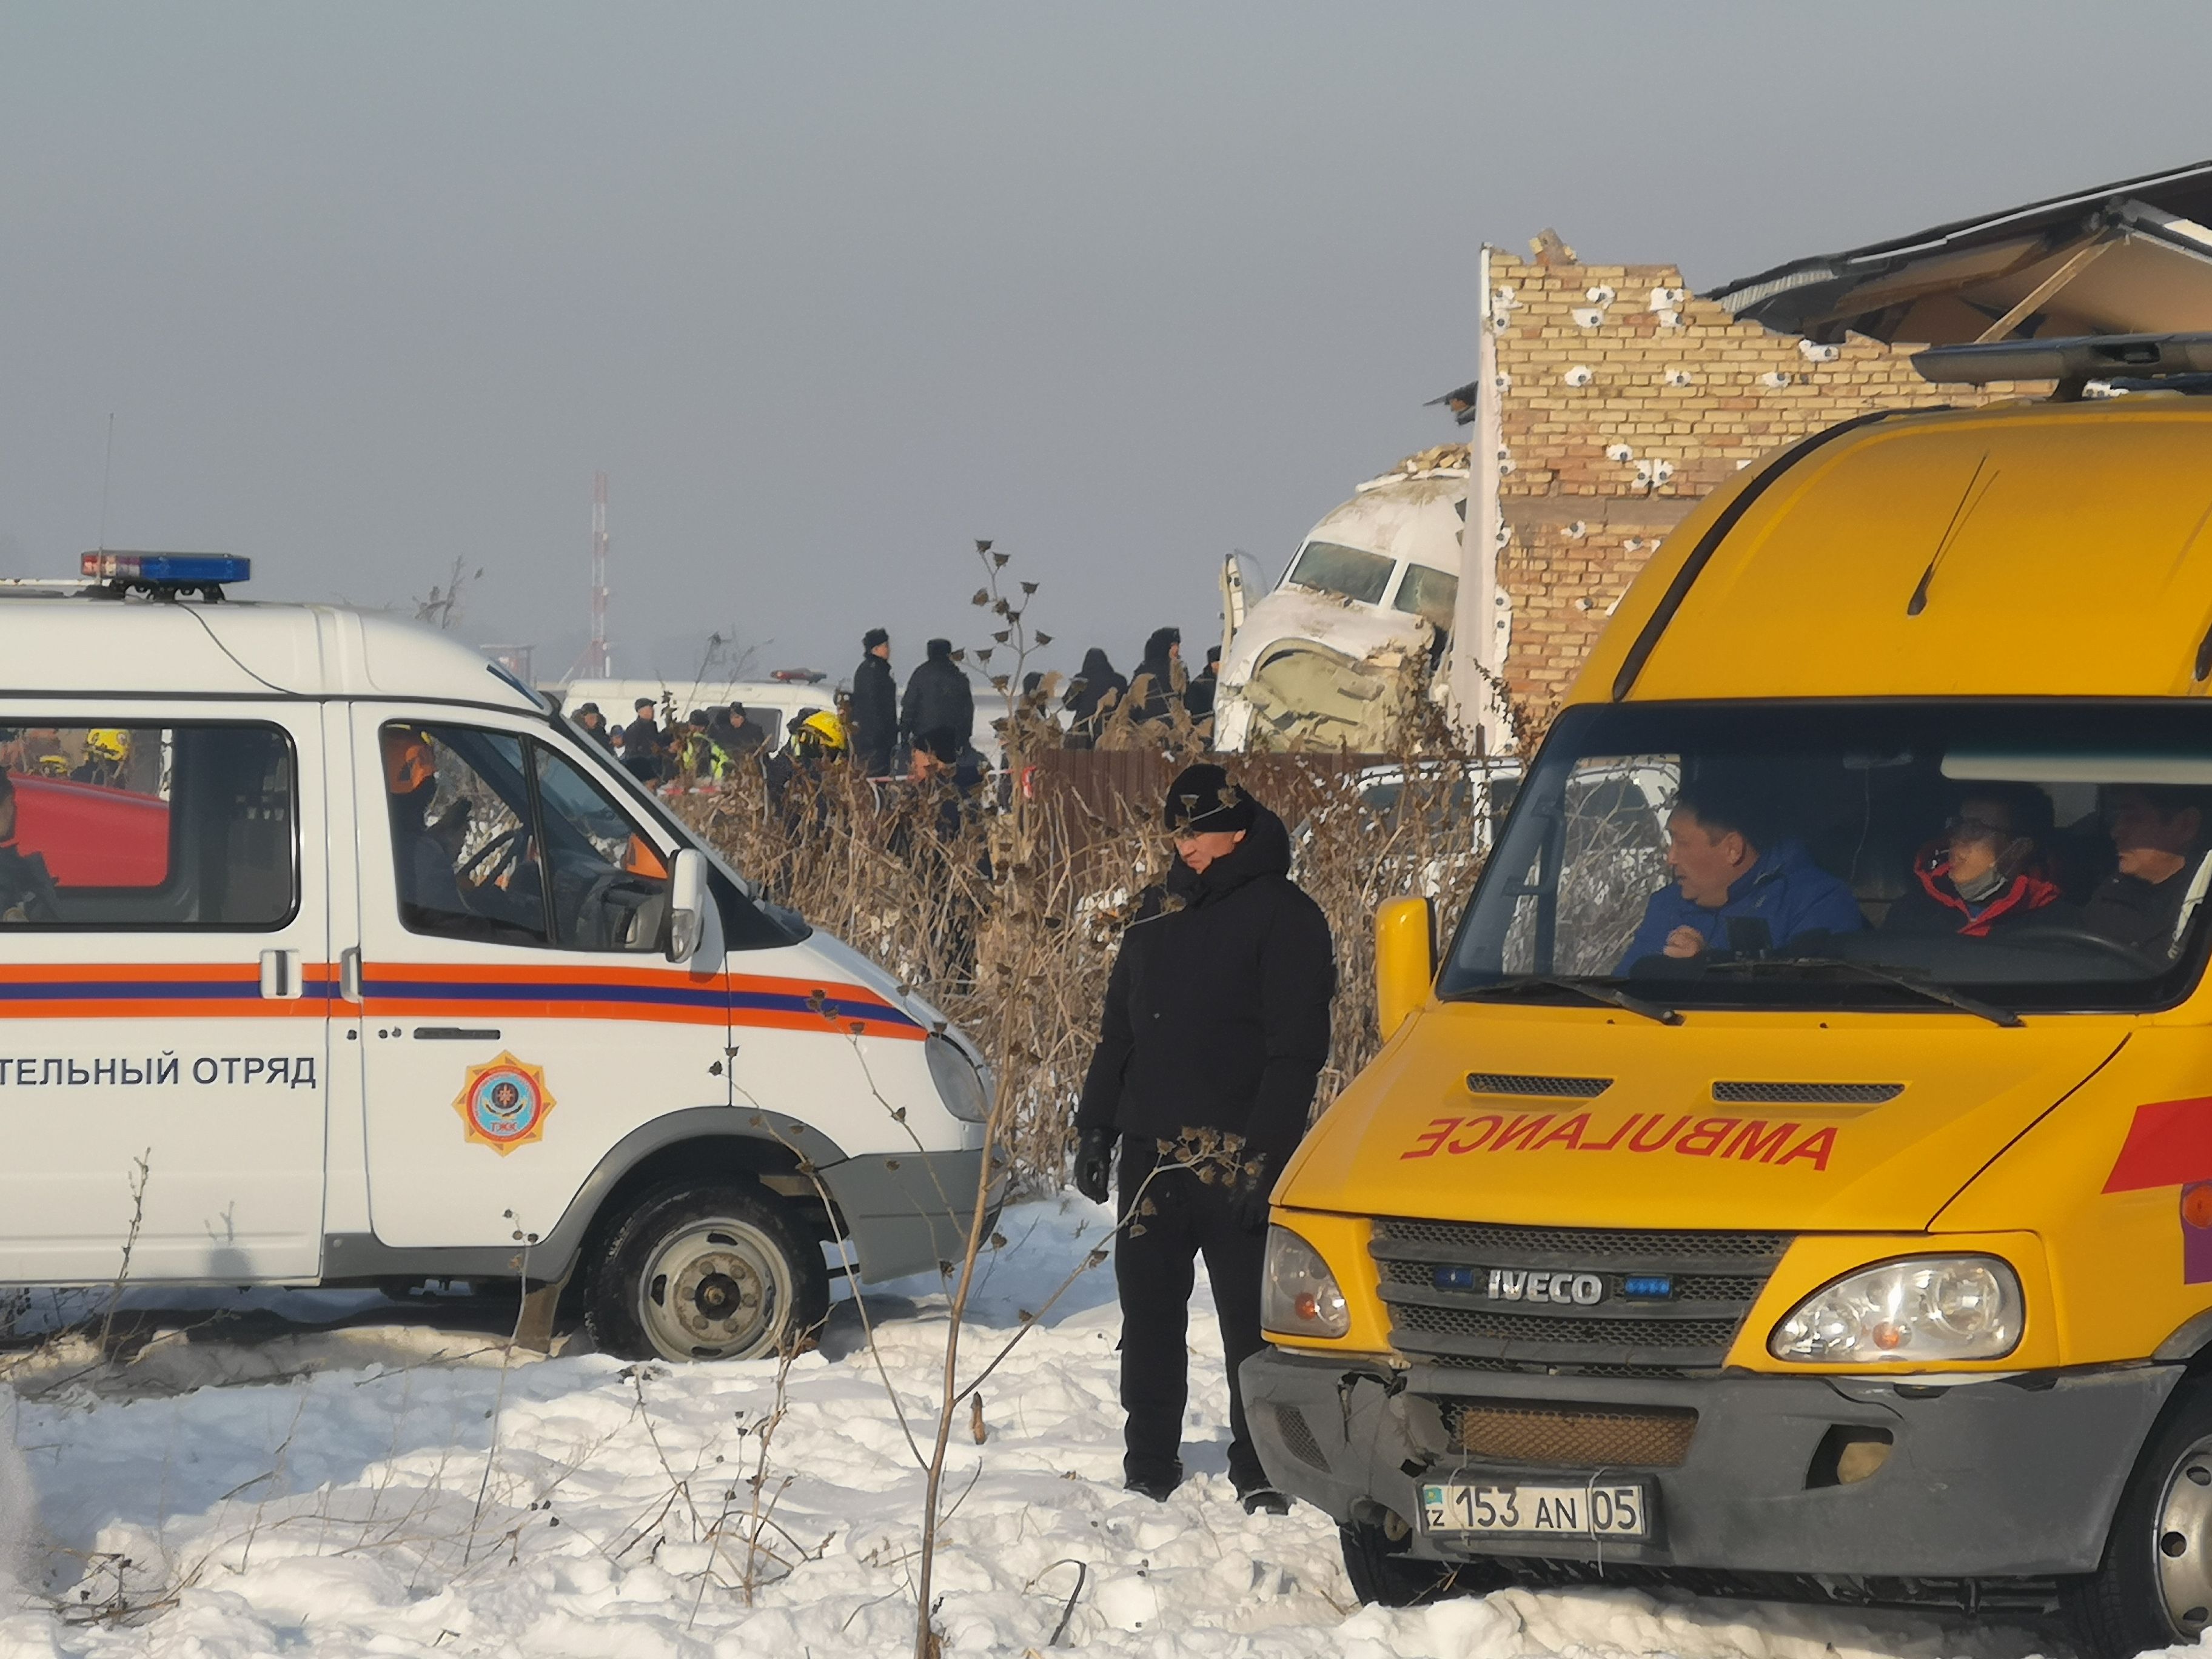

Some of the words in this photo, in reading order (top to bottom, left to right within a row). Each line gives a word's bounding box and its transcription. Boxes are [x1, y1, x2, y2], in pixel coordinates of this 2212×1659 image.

[0, 1050, 178, 1085] ТЕЛЬНЫЙ
[192, 1057, 317, 1089] ОТРЯД
[1487, 1269, 1603, 1305] IVECO
[1455, 1487, 1520, 1527] 153
[1535, 1496, 1577, 1529] AN
[1593, 1489, 1638, 1530] 05
